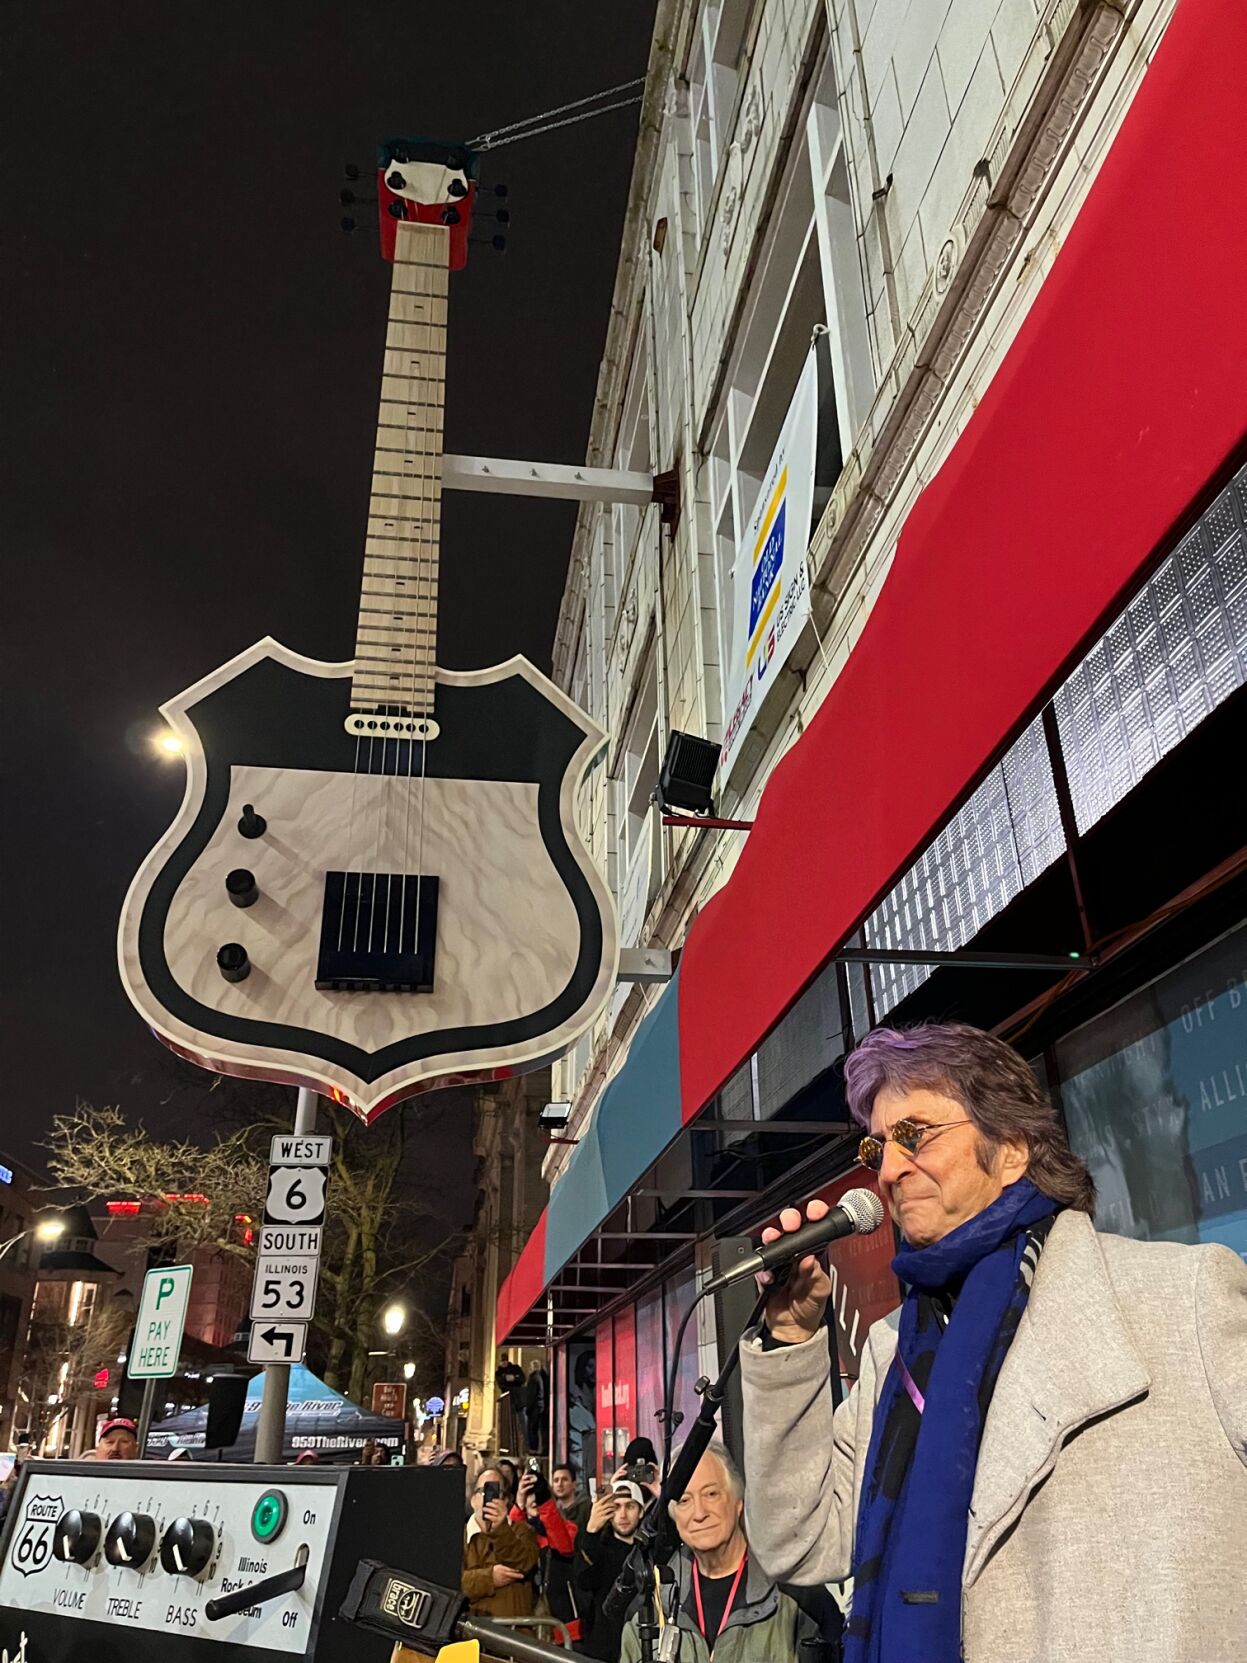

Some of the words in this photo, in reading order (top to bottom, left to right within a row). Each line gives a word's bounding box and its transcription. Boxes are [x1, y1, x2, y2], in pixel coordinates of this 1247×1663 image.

[1180, 989, 1215, 1033] OFF
[281, 1142, 324, 1159] WEST
[286, 1178, 307, 1210] 6
[1202, 1165, 1231, 1202] AN
[263, 1232, 318, 1250] SOUTH
[265, 1264, 308, 1274] ILLINOIS
[155, 1277, 175, 1311] P
[261, 1279, 305, 1310] 53
[147, 1320, 171, 1341] PAY
[138, 1346, 170, 1368] HERE
[303, 1401, 341, 1410] River
[30, 1504, 58, 1518] ROUTE
[303, 1509, 316, 1525] On
[18, 1524, 49, 1565] 66
[238, 1556, 268, 1574] Illinois
[53, 1588, 87, 1610] VOLUME
[106, 1597, 142, 1619] TREBLE
[165, 1604, 198, 1627] BASS
[282, 1611, 298, 1628] Off
